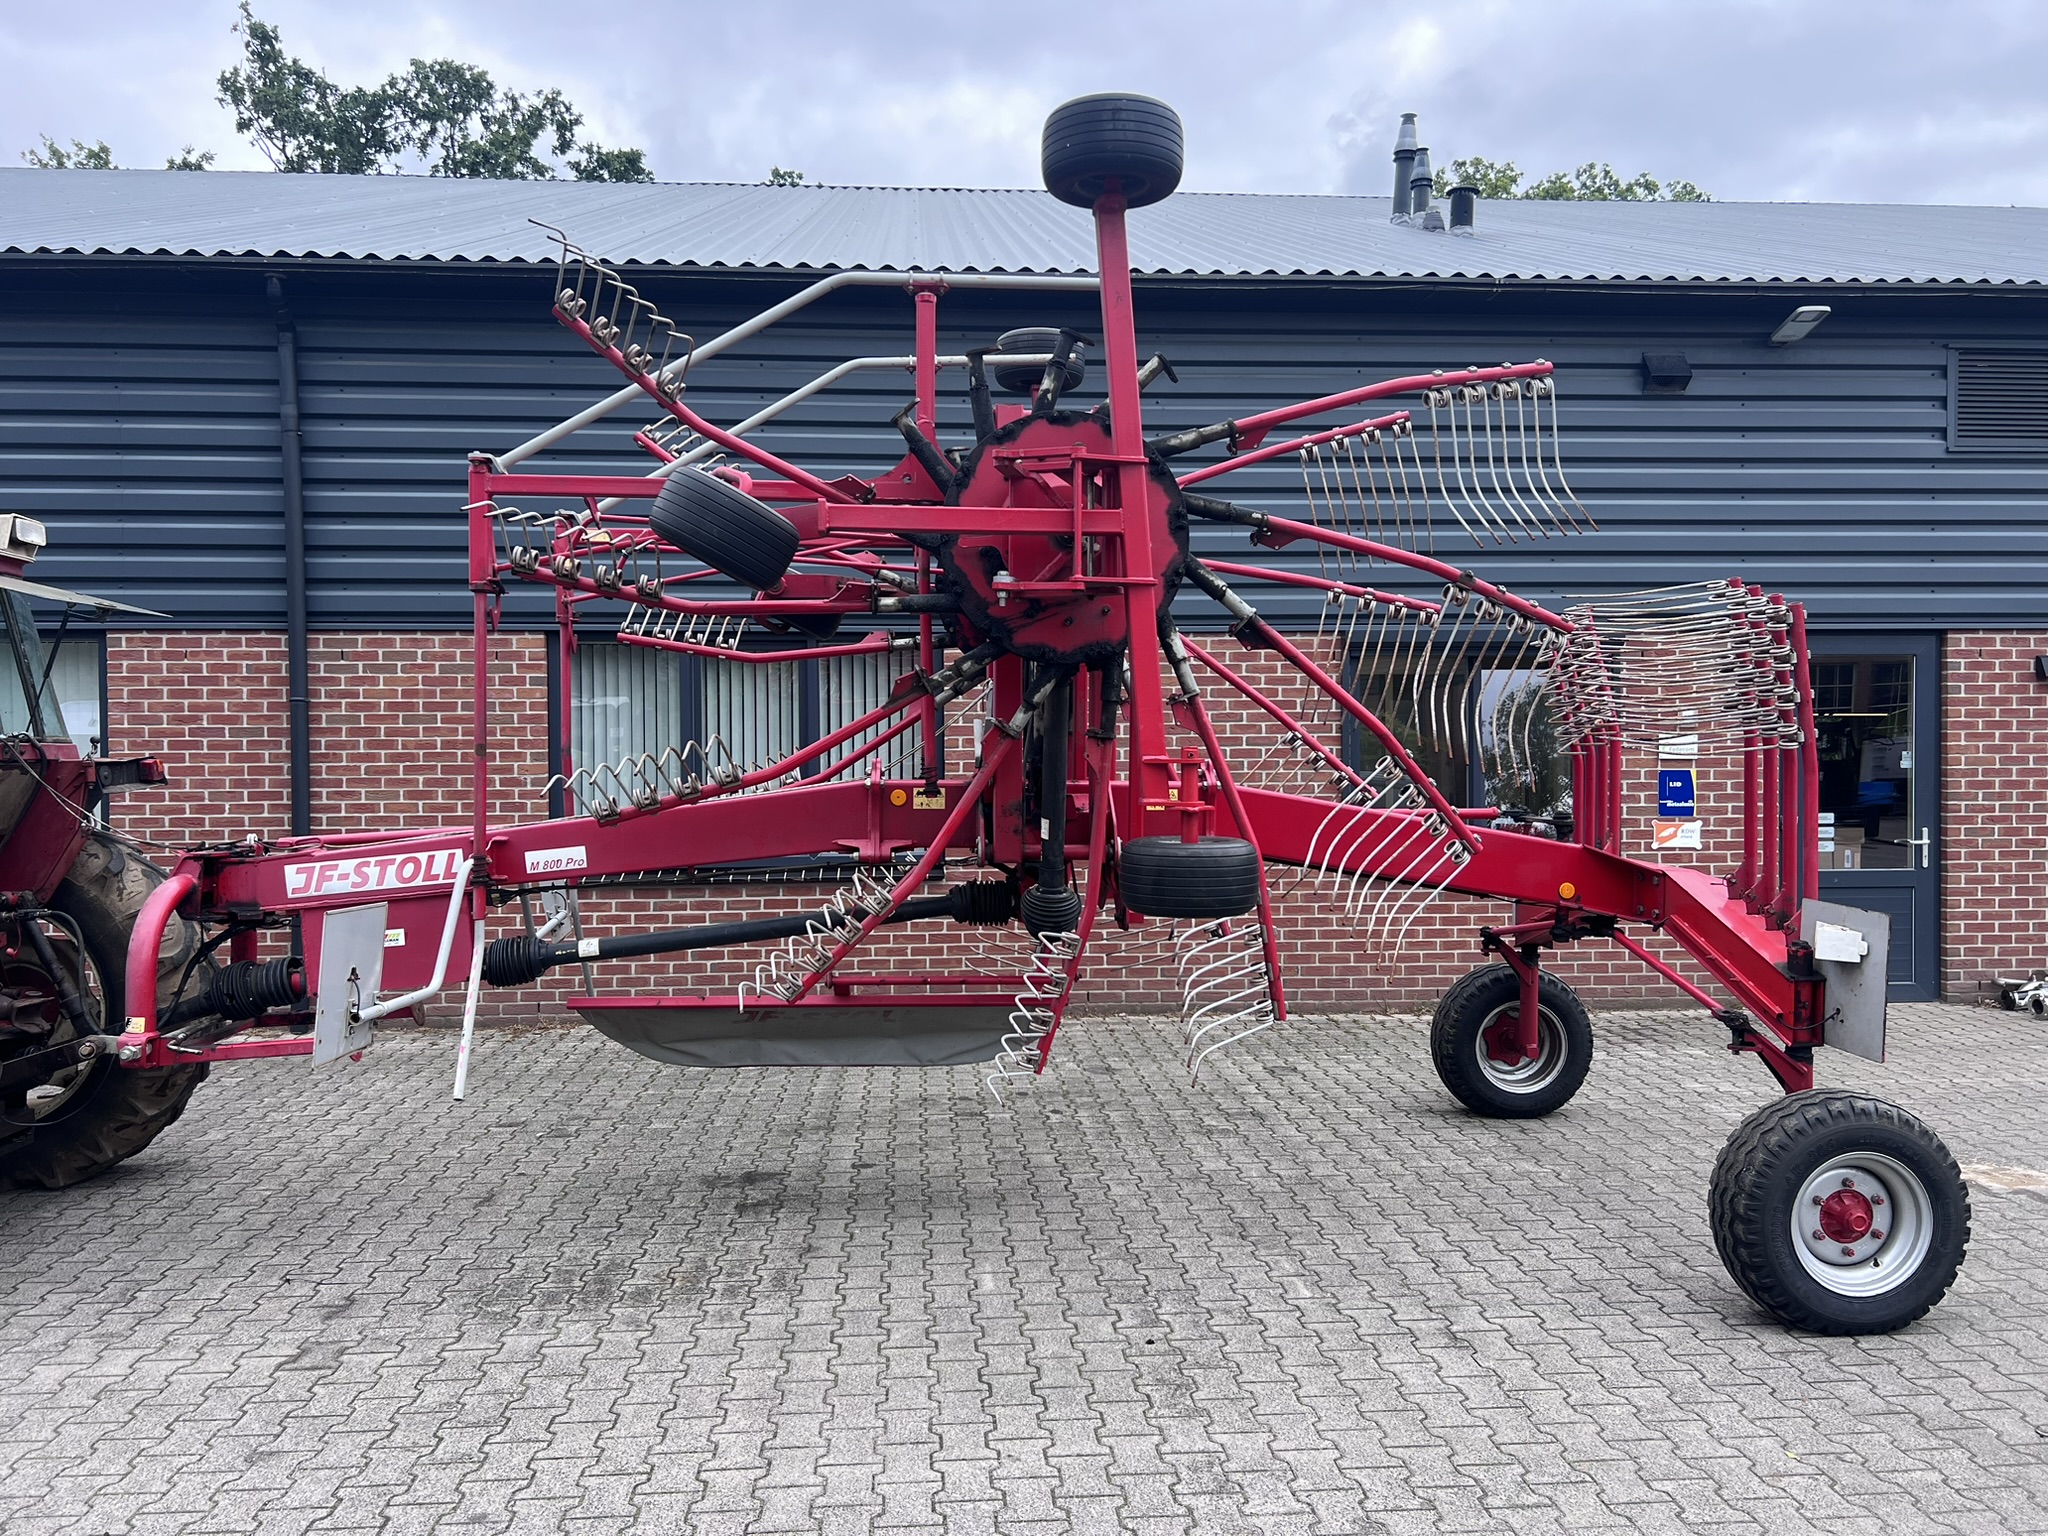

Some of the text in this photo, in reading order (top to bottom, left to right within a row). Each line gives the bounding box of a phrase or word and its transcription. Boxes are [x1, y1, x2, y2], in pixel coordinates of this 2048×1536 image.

[291, 852, 459, 895] JF-STOLL
[530, 857, 585, 871] M 800 Pro
